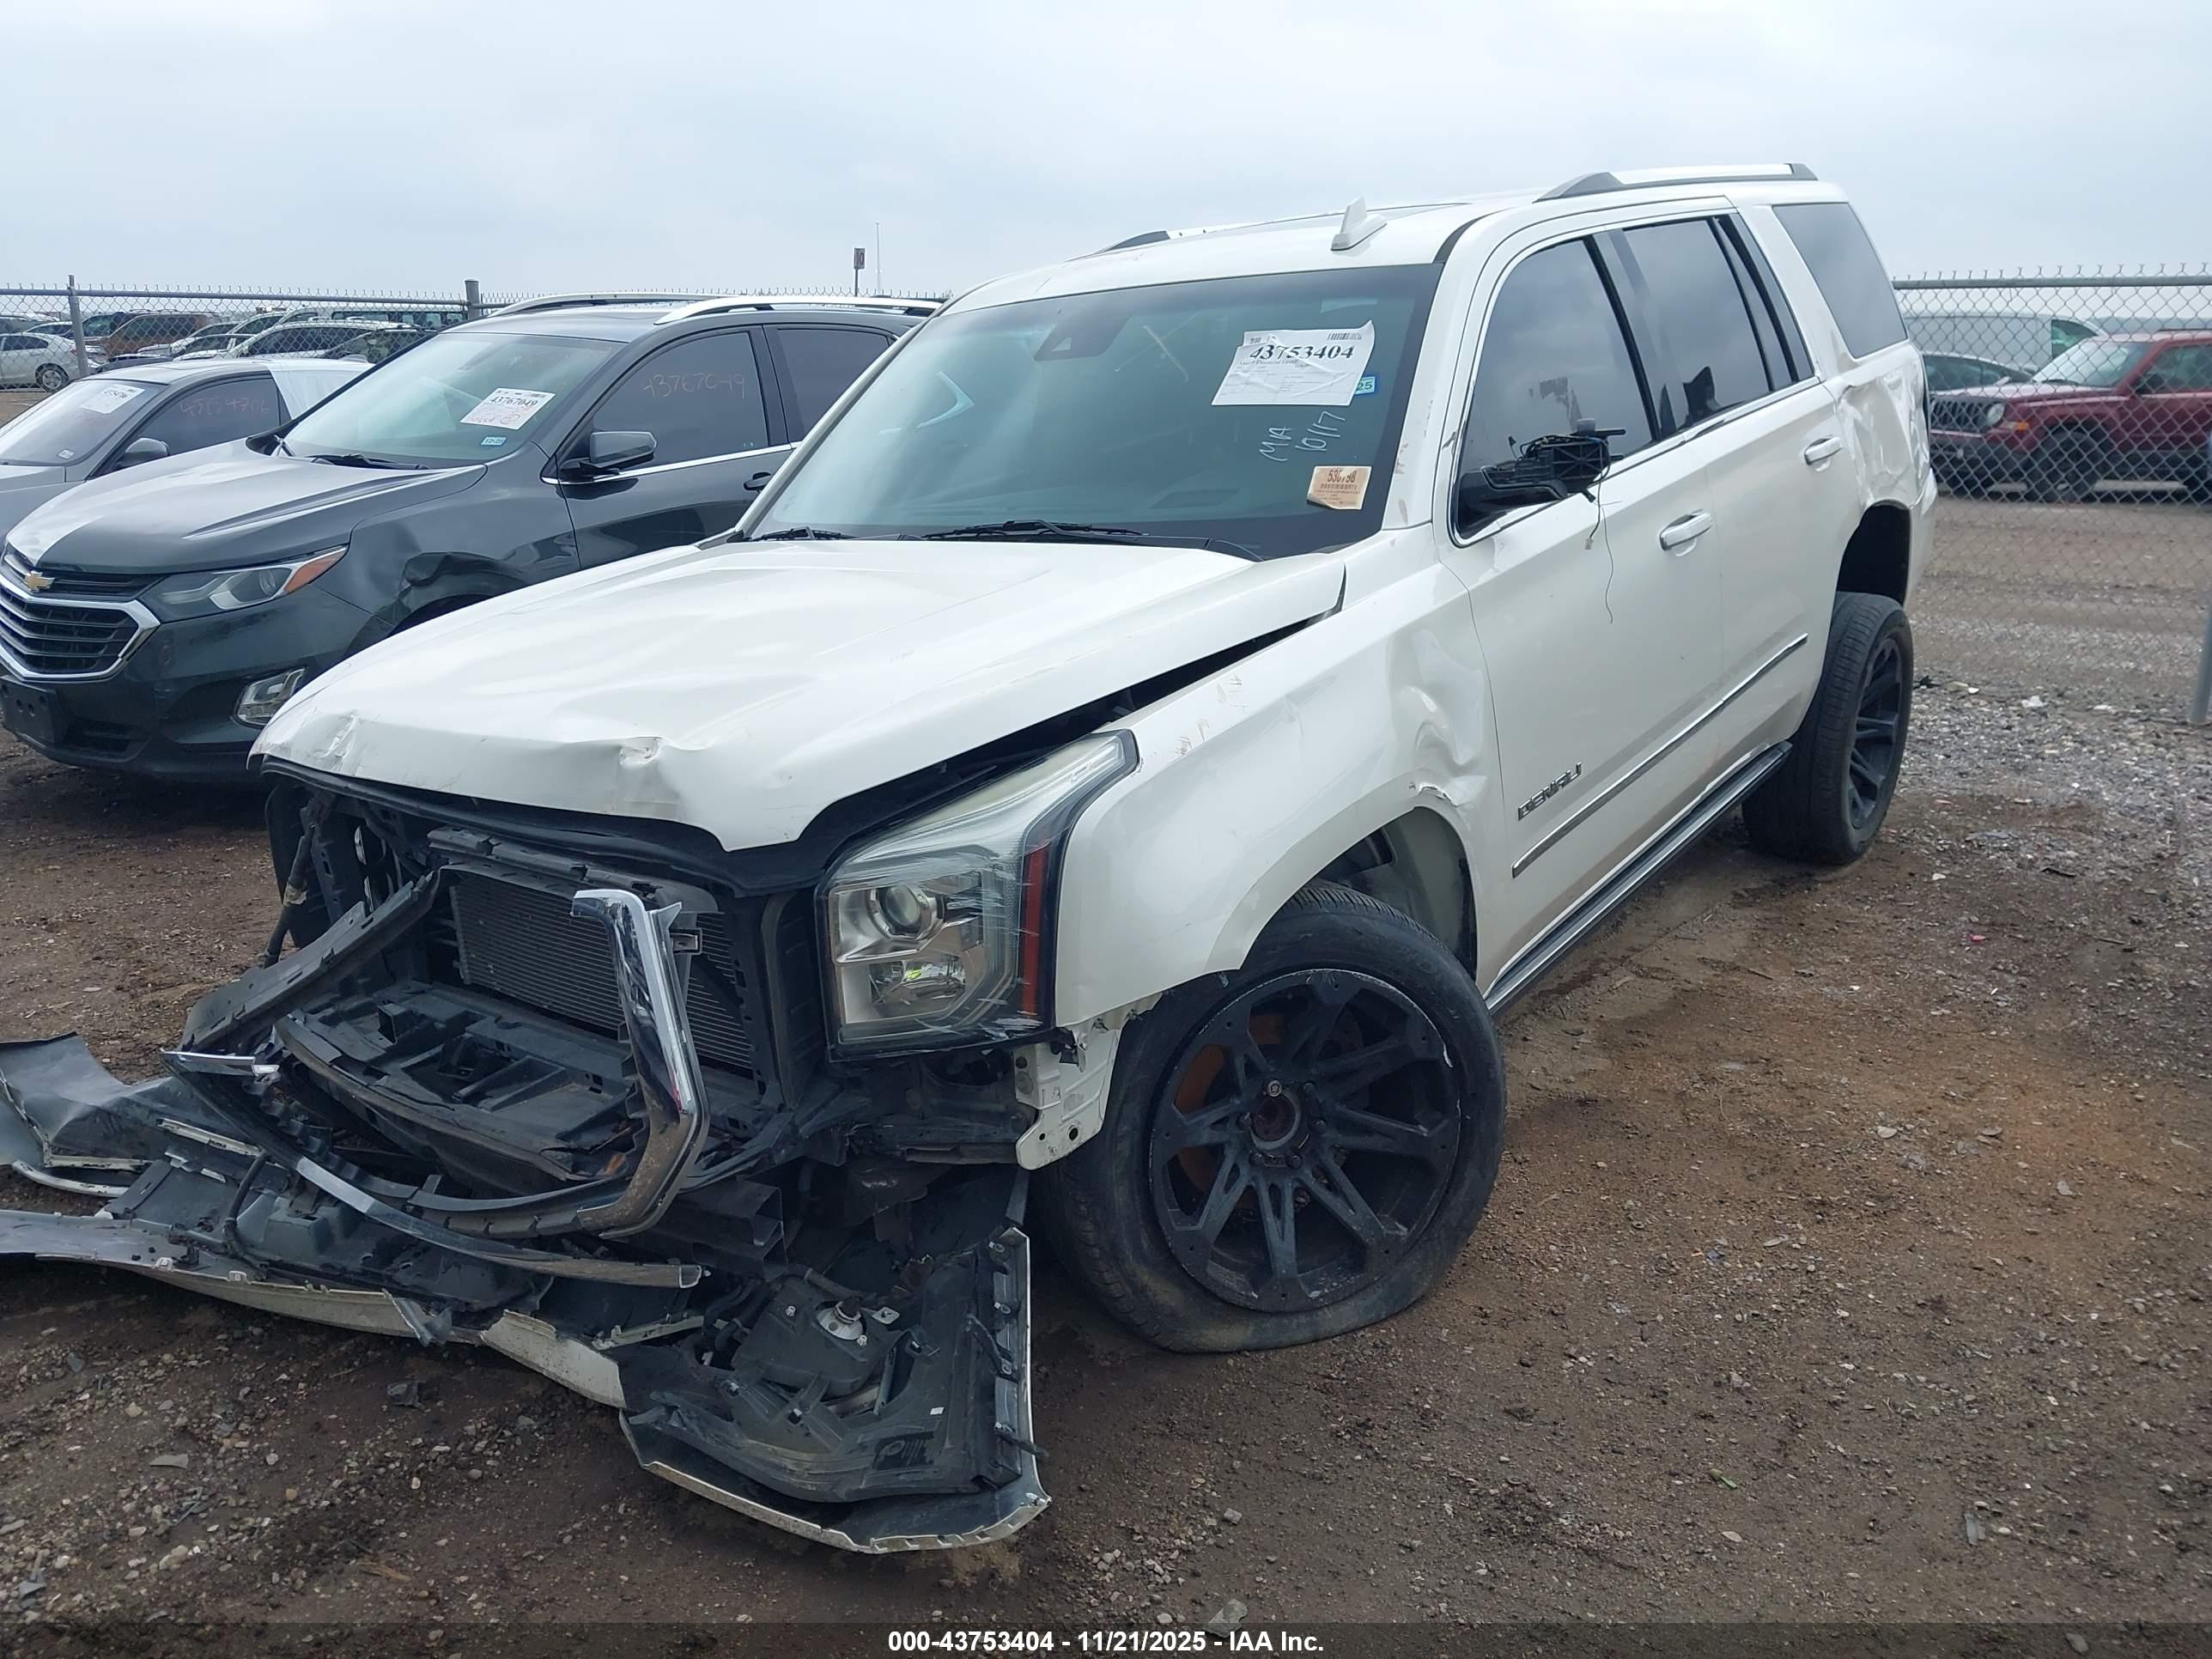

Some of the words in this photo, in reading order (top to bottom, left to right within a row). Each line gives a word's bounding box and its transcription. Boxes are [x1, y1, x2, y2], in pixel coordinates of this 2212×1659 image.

[1250, 344, 1353, 360] 43753404
[490, 396, 538, 406] 43767049
[1518, 762, 1582, 822] DENALI
